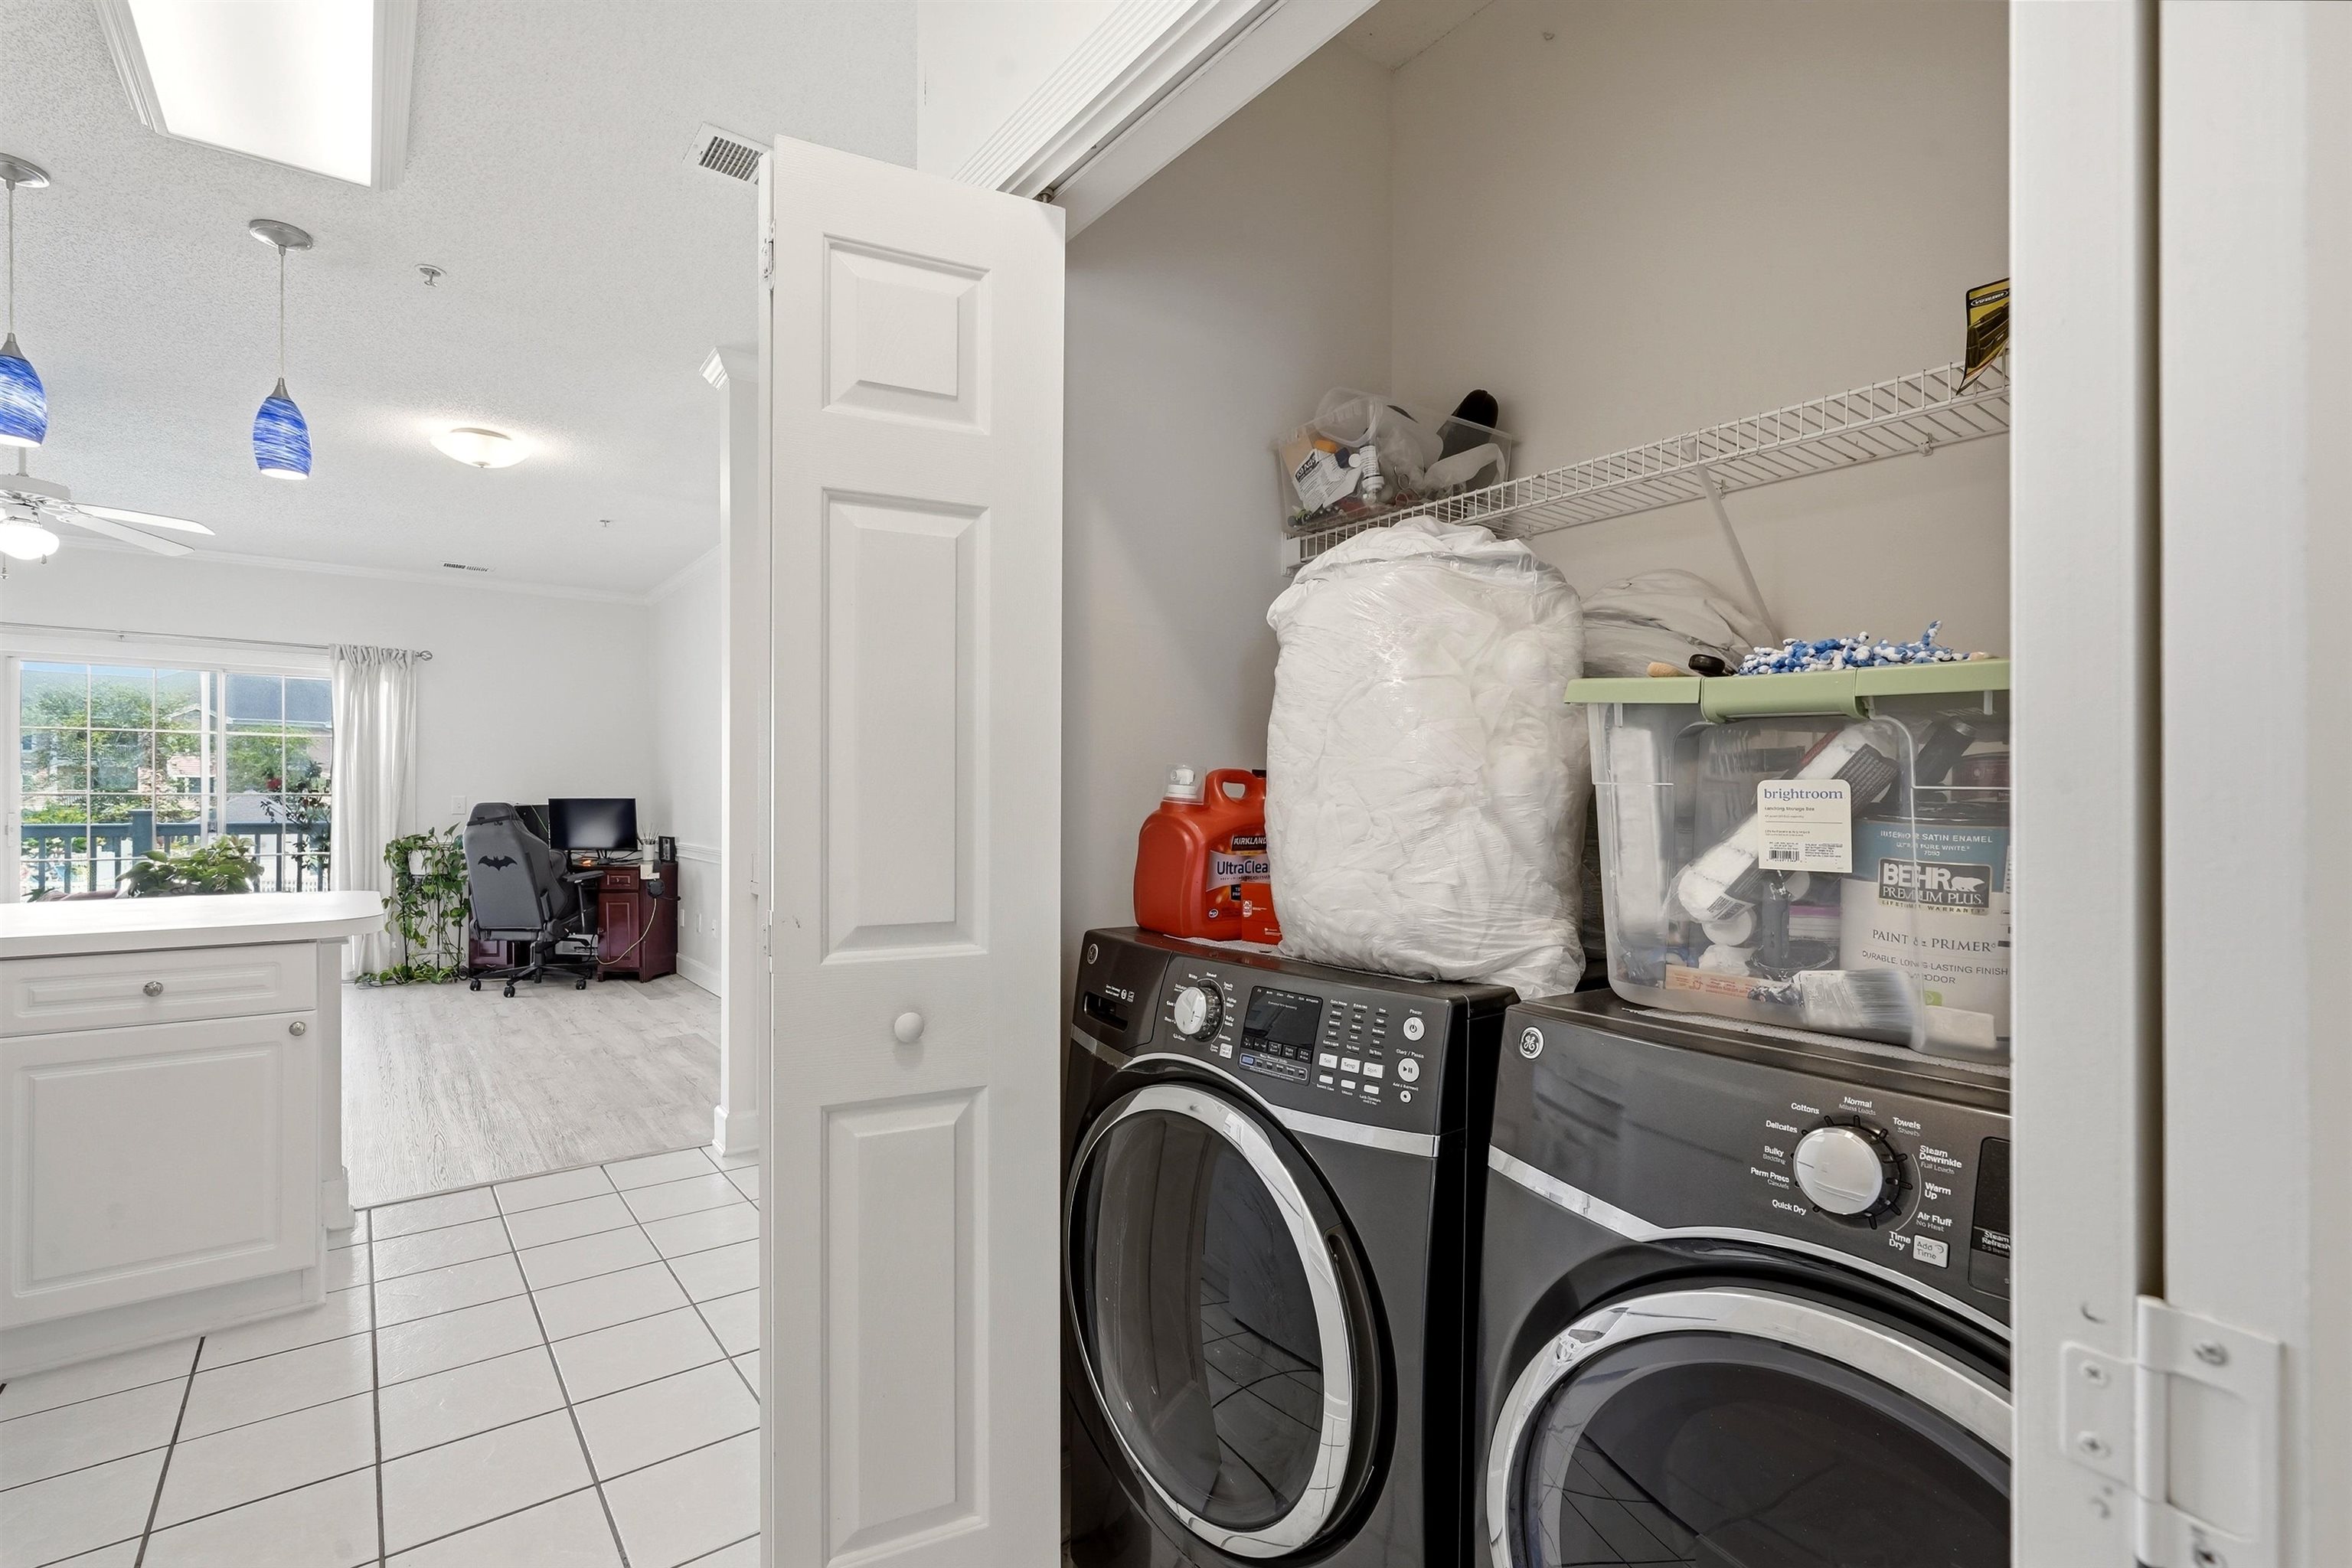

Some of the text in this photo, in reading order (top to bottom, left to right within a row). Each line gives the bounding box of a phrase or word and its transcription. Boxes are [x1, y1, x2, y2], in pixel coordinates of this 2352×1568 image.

[1764, 789, 1843, 802] brightroom
[1953, 835, 1993, 843] ENAMEL
[1217, 861, 1270, 875] UltraClea
[1883, 862, 1953, 892] BEHR
[1873, 929, 1909, 945] PAINT
[1976, 966, 2009, 975] FINISH
[1791, 1102, 1820, 1114] Cottons
[1844, 1096, 1872, 1108] Normal
[1766, 1120, 1798, 1133] Delicates
[1893, 1117, 1921, 1129] Towels
[1764, 1145, 1784, 1158] Bulky
[1919, 1145, 1948, 1158] Steam
[1919, 1152, 1962, 1168] Dewrinkle
[1750, 1167, 1769, 1178] Perm
[1924, 1190, 1938, 1200] Up
[1925, 1182, 1952, 1196] Warm
[1772, 1199, 1807, 1216] Quick Dry
[1917, 1211, 1952, 1227] Air Fluff
[1889, 1230, 1911, 1244] Time
[1984, 1231, 2009, 1244] Steam
[1889, 1238, 1906, 1251] Dry
[1917, 1241, 1932, 1251] Add
[1916, 1249, 1937, 1259] Time
